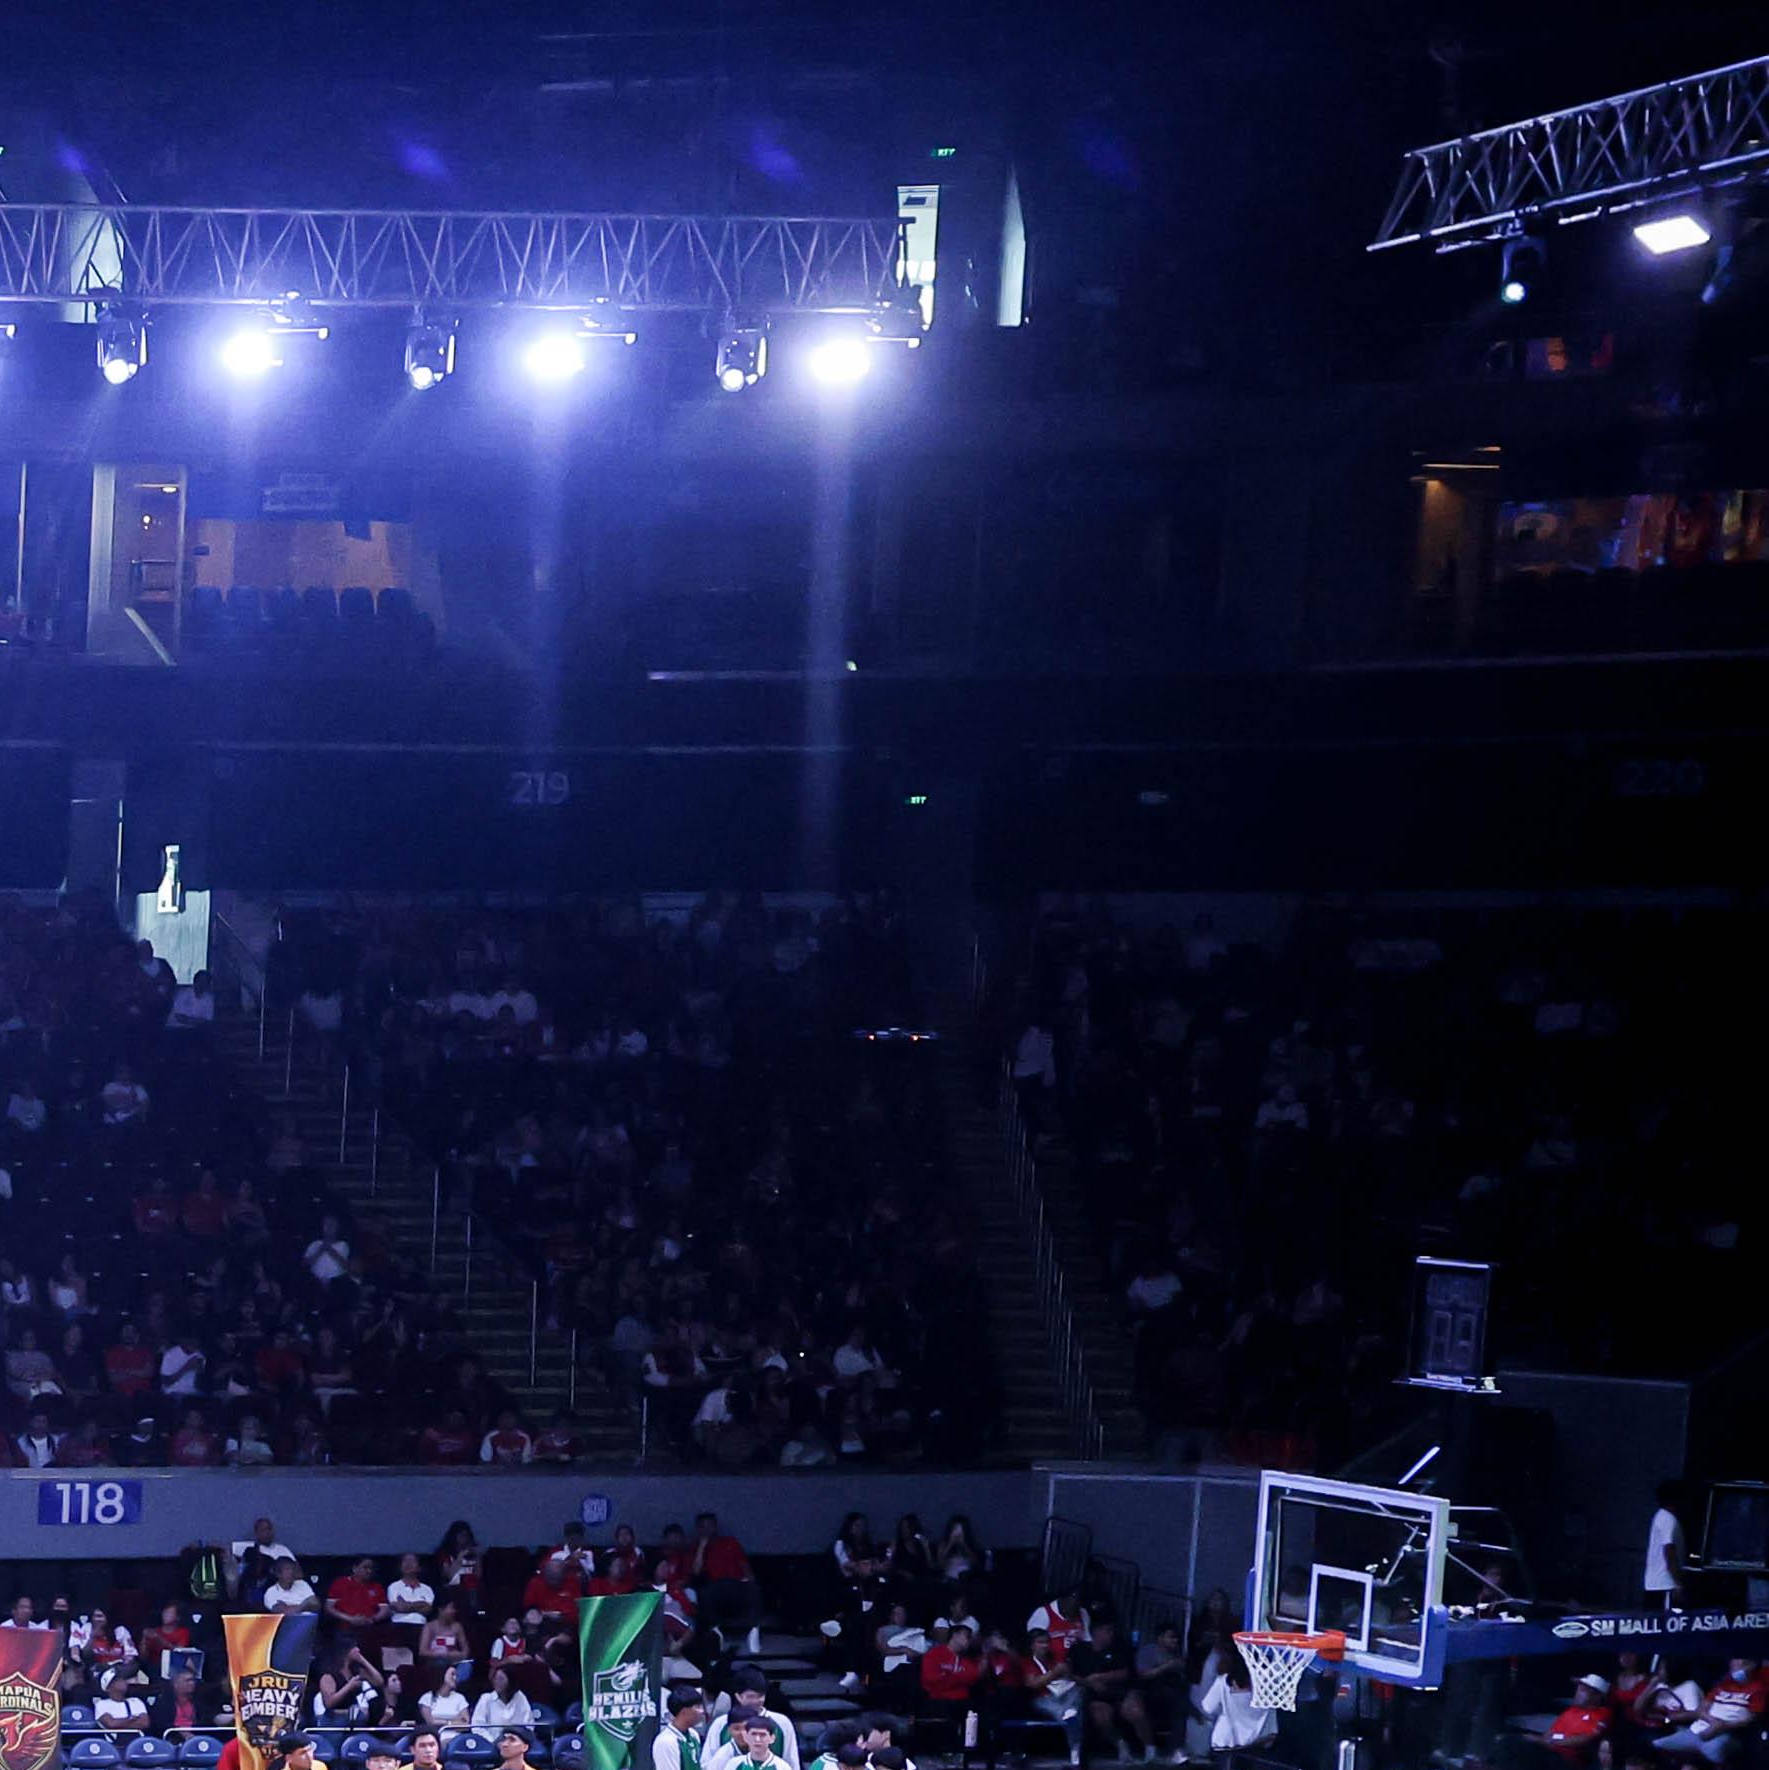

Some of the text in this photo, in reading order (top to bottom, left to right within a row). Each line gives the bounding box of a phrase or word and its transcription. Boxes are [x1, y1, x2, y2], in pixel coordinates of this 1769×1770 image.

[512, 771, 570, 805] 219
[55, 1482, 125, 1524] 118
[1591, 1620, 1614, 1636] SM
[1618, 1618, 1662, 1636] MALL
[1666, 1616, 1687, 1633] OF
[1692, 1615, 1730, 1632] ASIA
[249, 1675, 288, 1690] JRU
